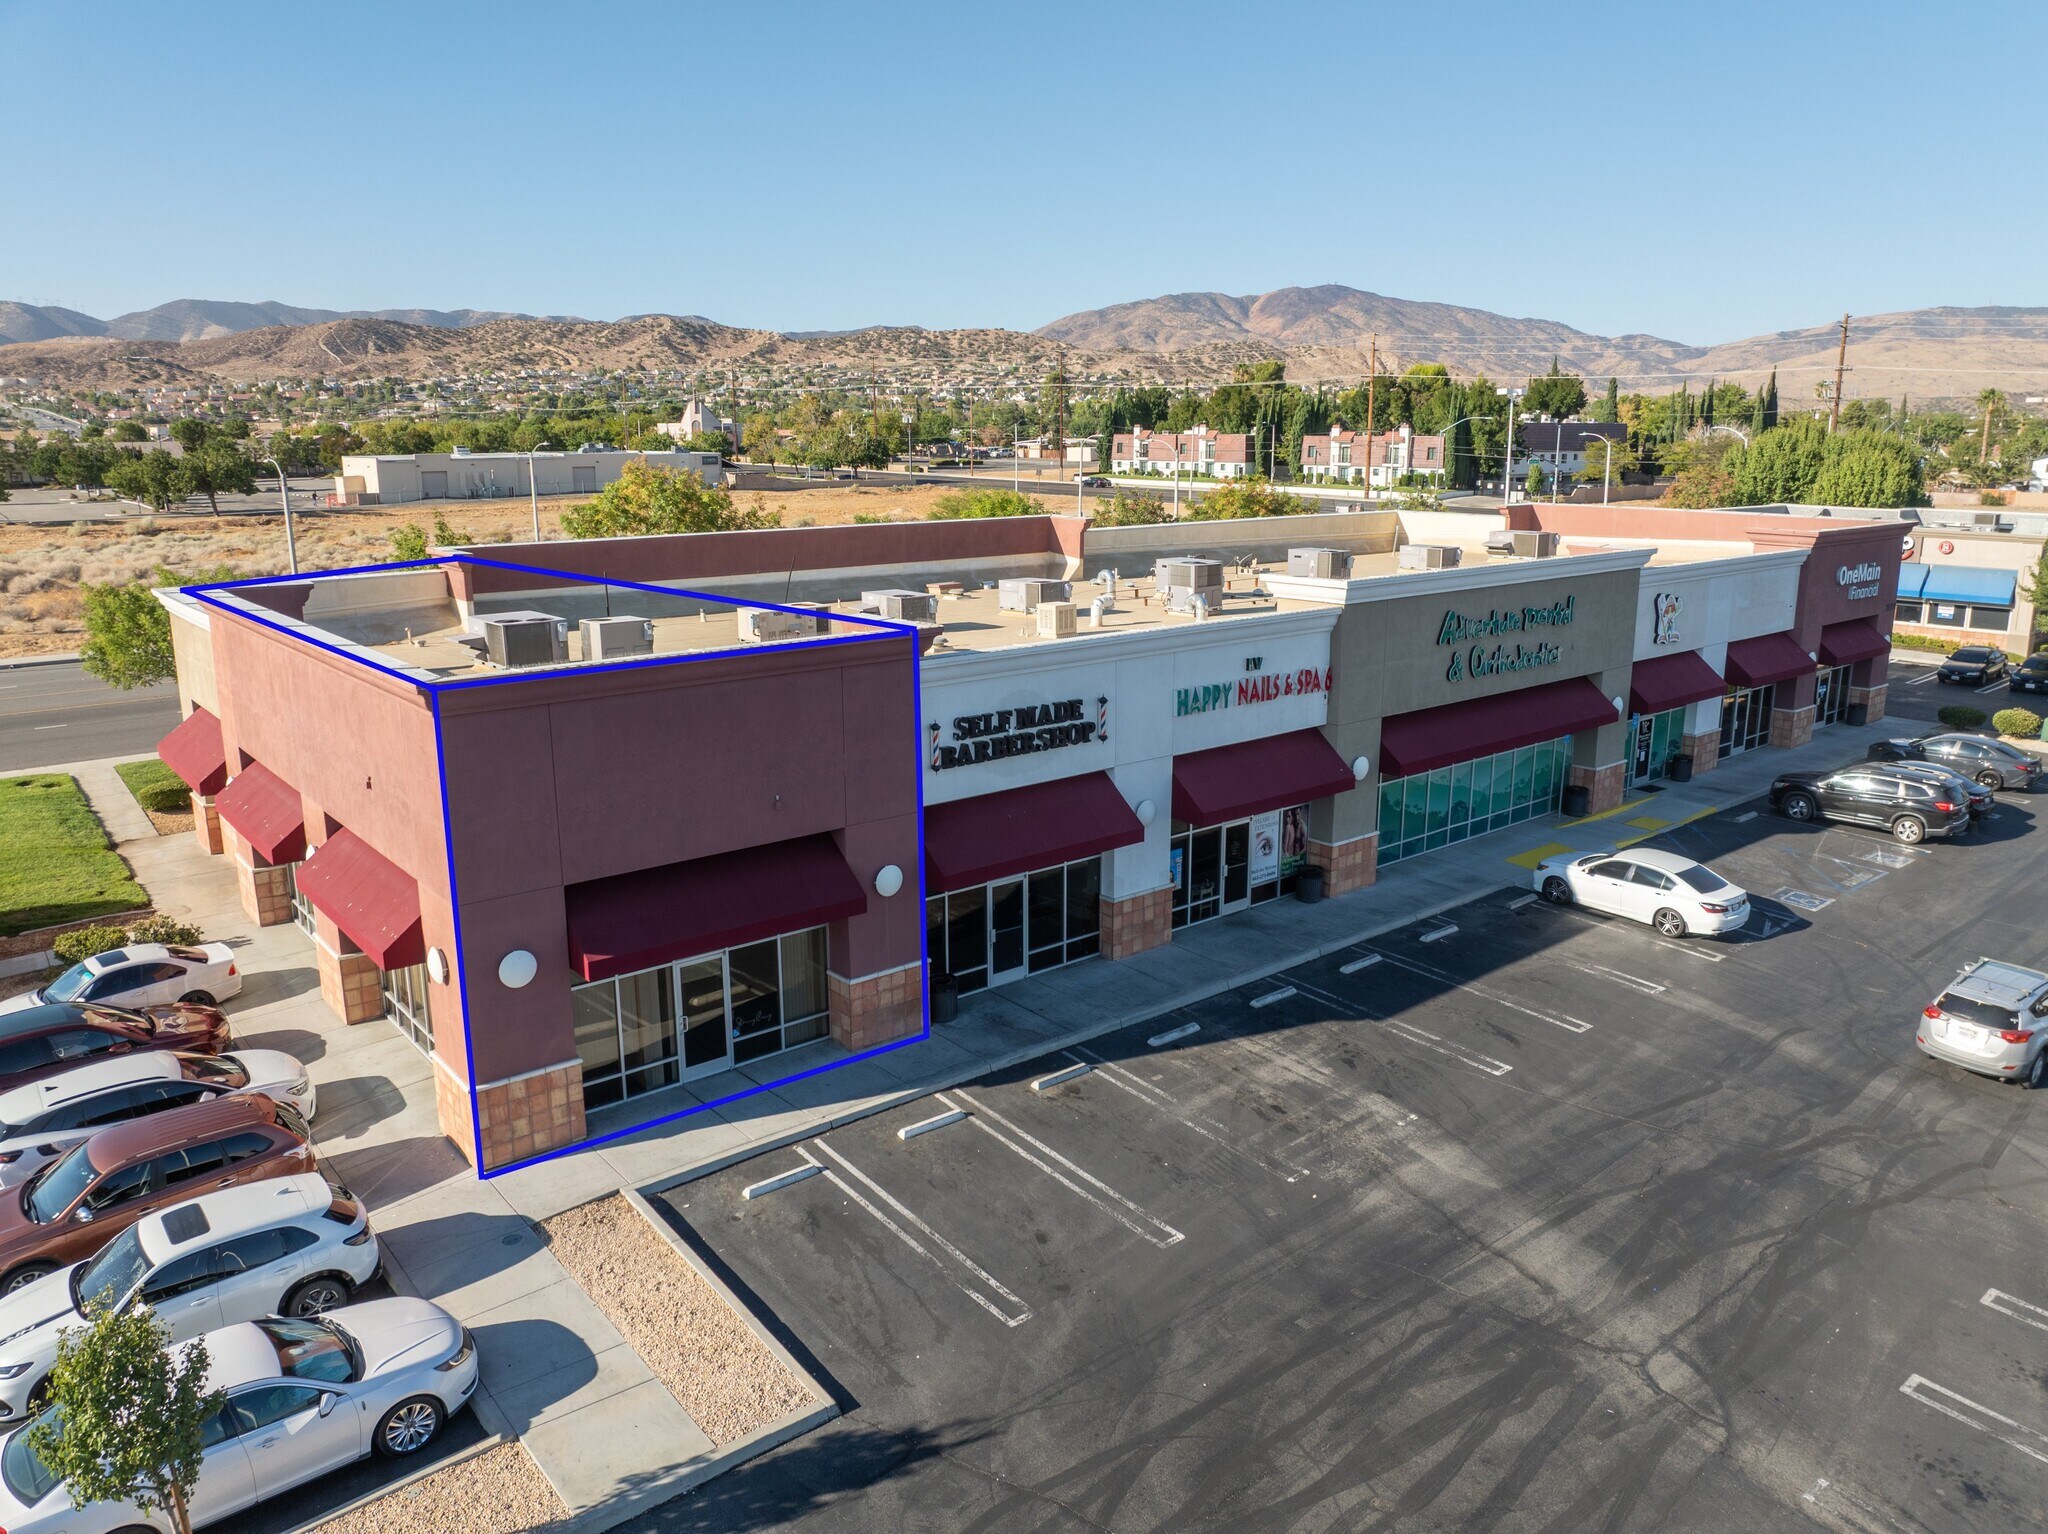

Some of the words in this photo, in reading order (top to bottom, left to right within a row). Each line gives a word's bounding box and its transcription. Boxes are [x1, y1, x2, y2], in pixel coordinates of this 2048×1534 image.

[1838, 562, 1881, 586] OneMain
[1848, 582, 1880, 600] Financial
[1437, 610, 1521, 646] Adventure
[1522, 595, 1575, 631] Dental
[1447, 651, 1464, 683] &
[1469, 642, 1564, 679] Orthodontics
[1175, 680, 1232, 717] HAPPY
[1235, 673, 1280, 706] NAILS
[1282, 673, 1293, 696] &
[1295, 667, 1321, 695] SPA
[1323, 665, 1333, 691] 6
[953, 709, 1013, 741] SELF
[1014, 698, 1084, 730] MADE
[940, 721, 1096, 769] BARBERSHOP
